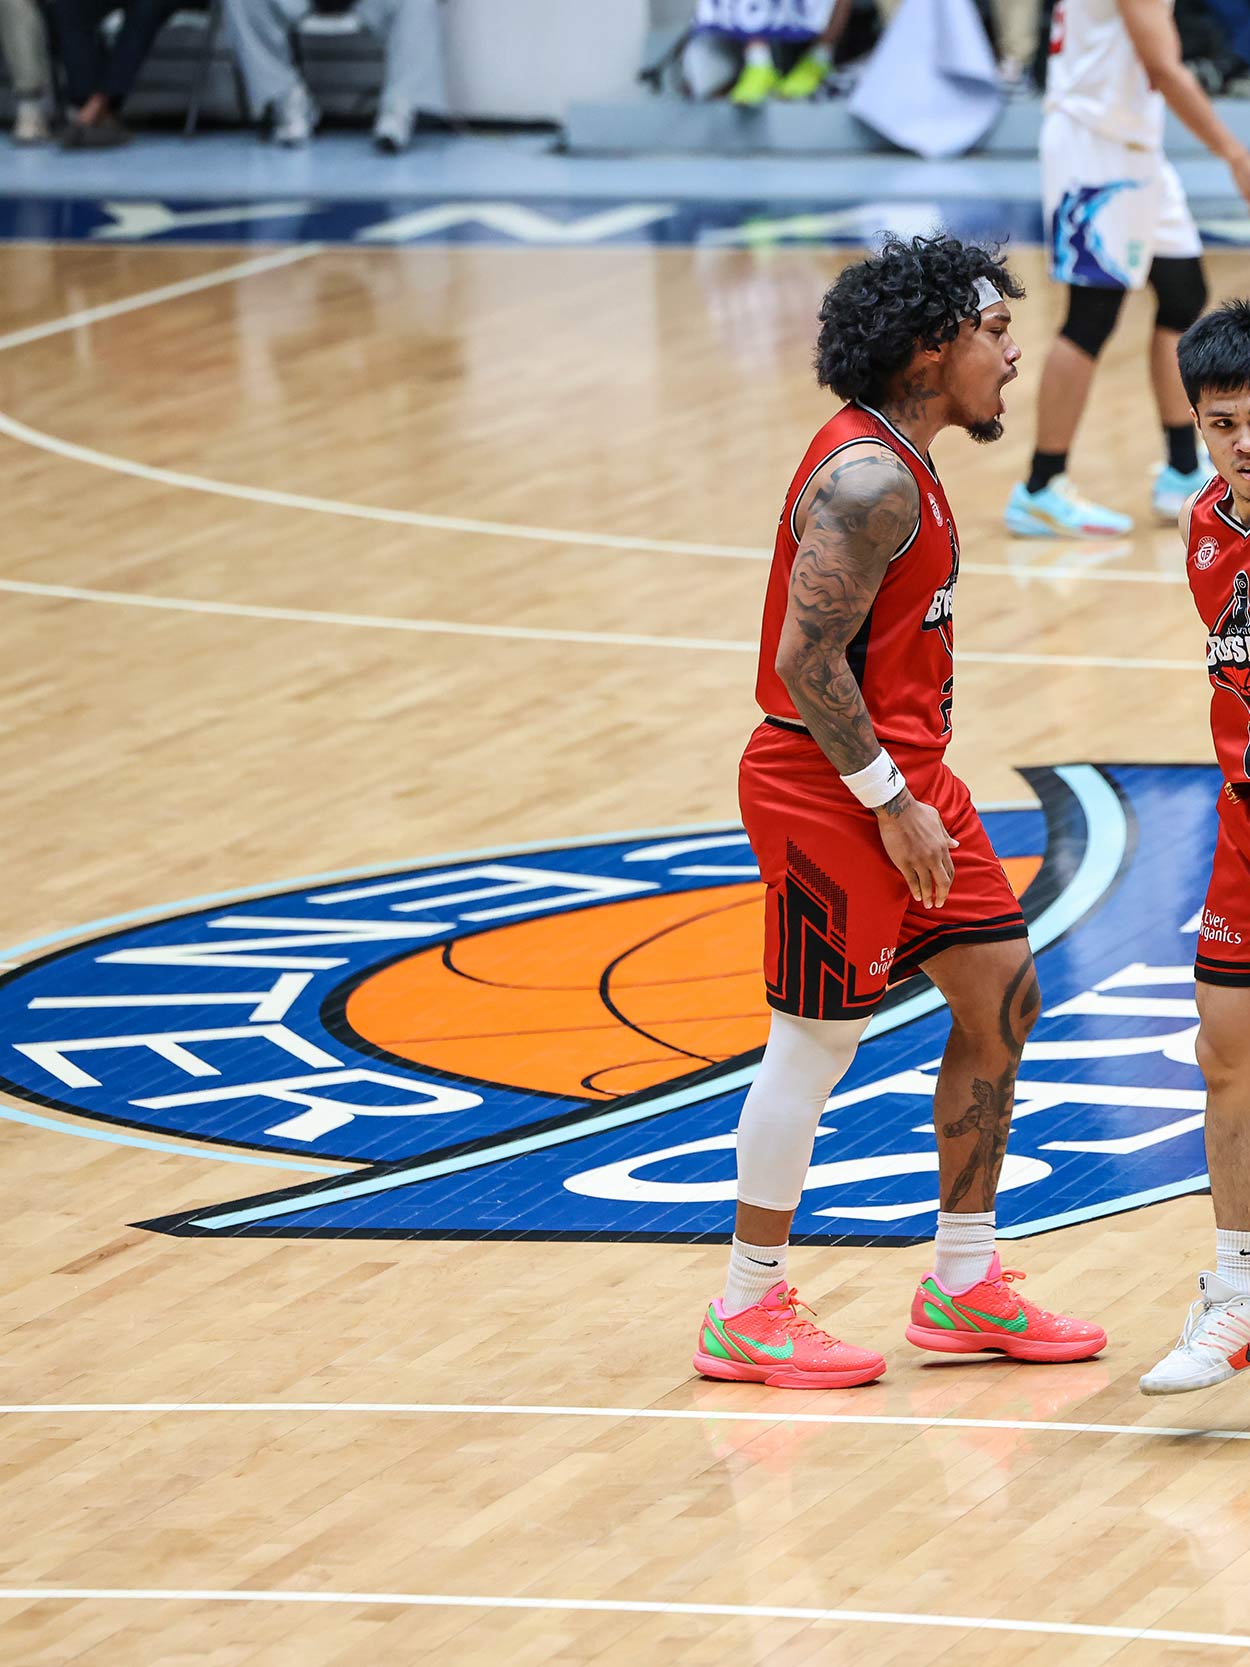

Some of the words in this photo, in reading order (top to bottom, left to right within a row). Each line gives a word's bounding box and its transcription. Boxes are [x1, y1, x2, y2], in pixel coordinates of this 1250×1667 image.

[1204, 909, 1227, 928] Ever
[1200, 921, 1242, 944] rganics
[880, 947, 897, 962] Eve
